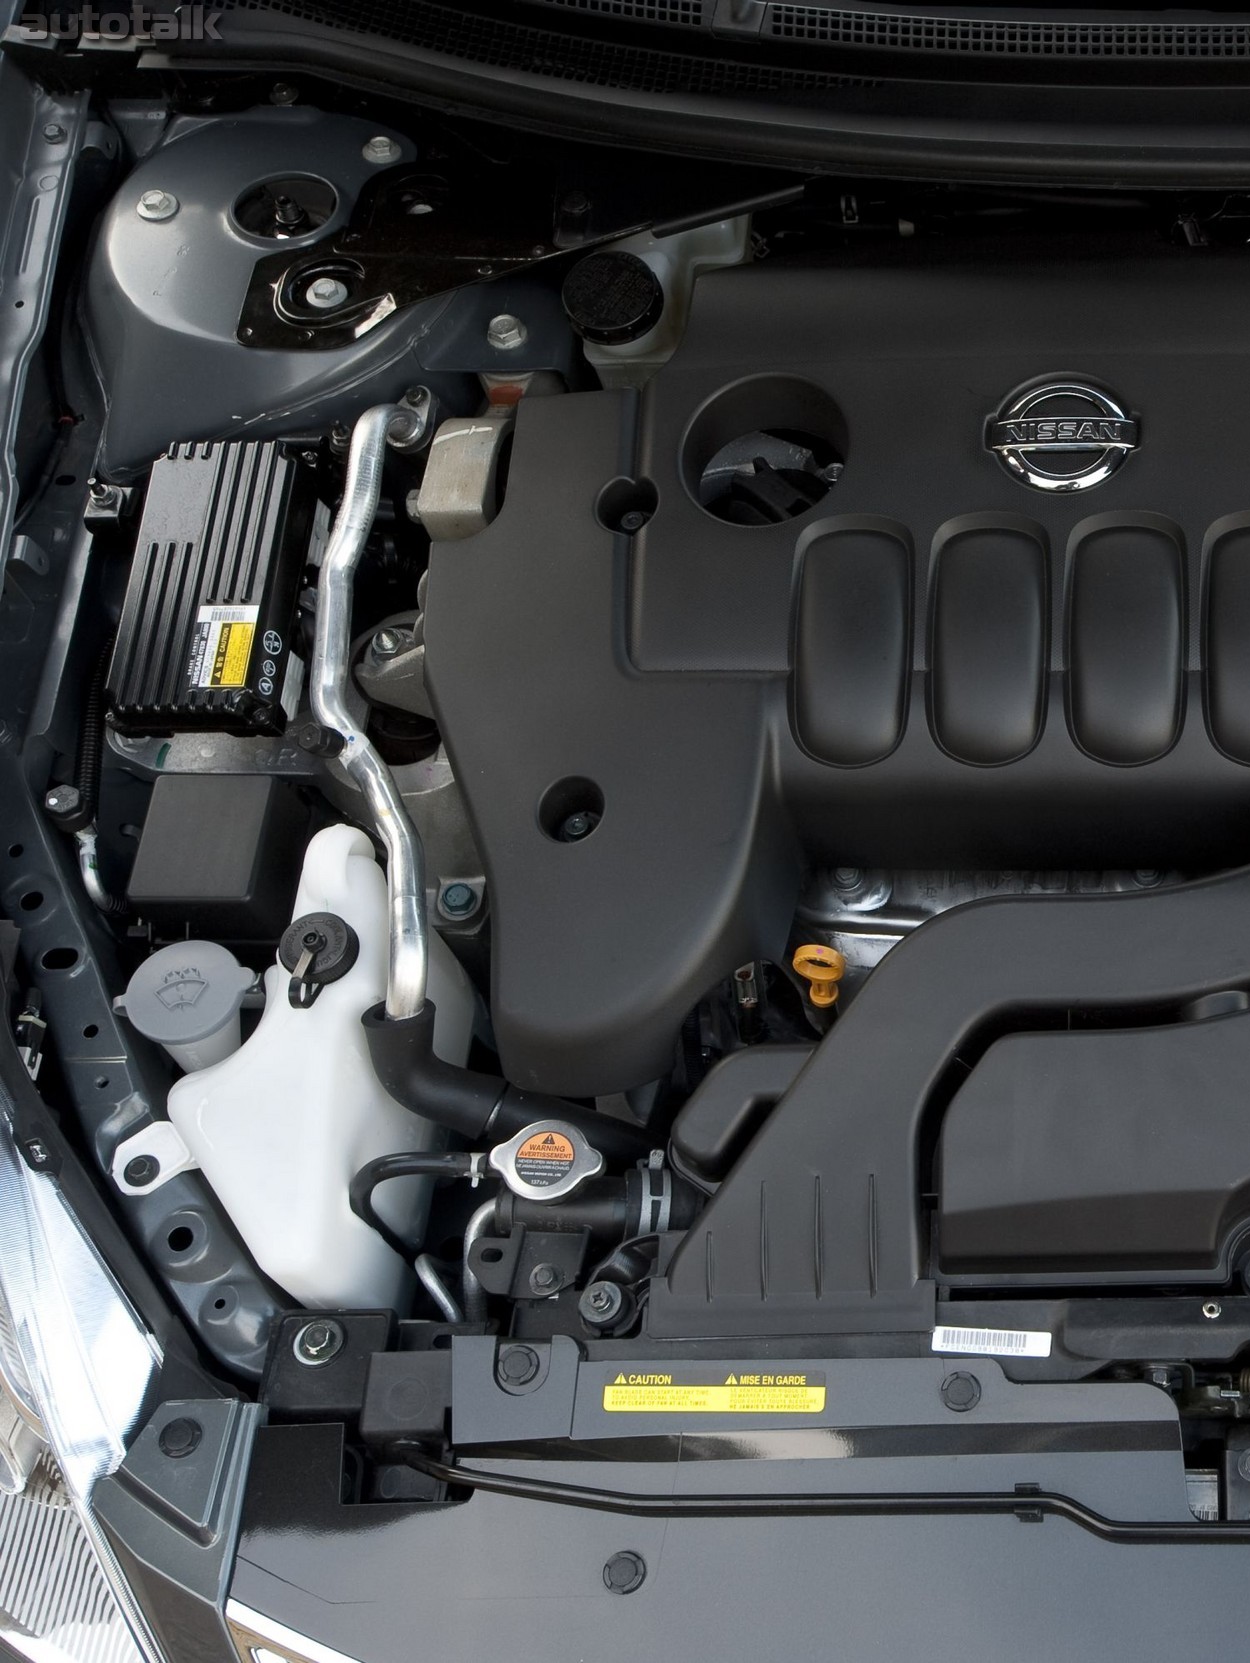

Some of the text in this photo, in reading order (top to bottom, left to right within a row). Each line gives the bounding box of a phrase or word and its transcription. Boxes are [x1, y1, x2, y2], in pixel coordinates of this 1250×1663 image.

[1006, 422, 1121, 442] NISSAN
[220, 628, 229, 652] CAUTION
[192, 655, 203, 684] NISSAN
[529, 1144, 565, 1152] WARNING
[520, 1151, 572, 1159] AVERTISSEMENT
[628, 1375, 672, 1385] CAUTION
[740, 1375, 806, 1385] MISE EN GARDE
